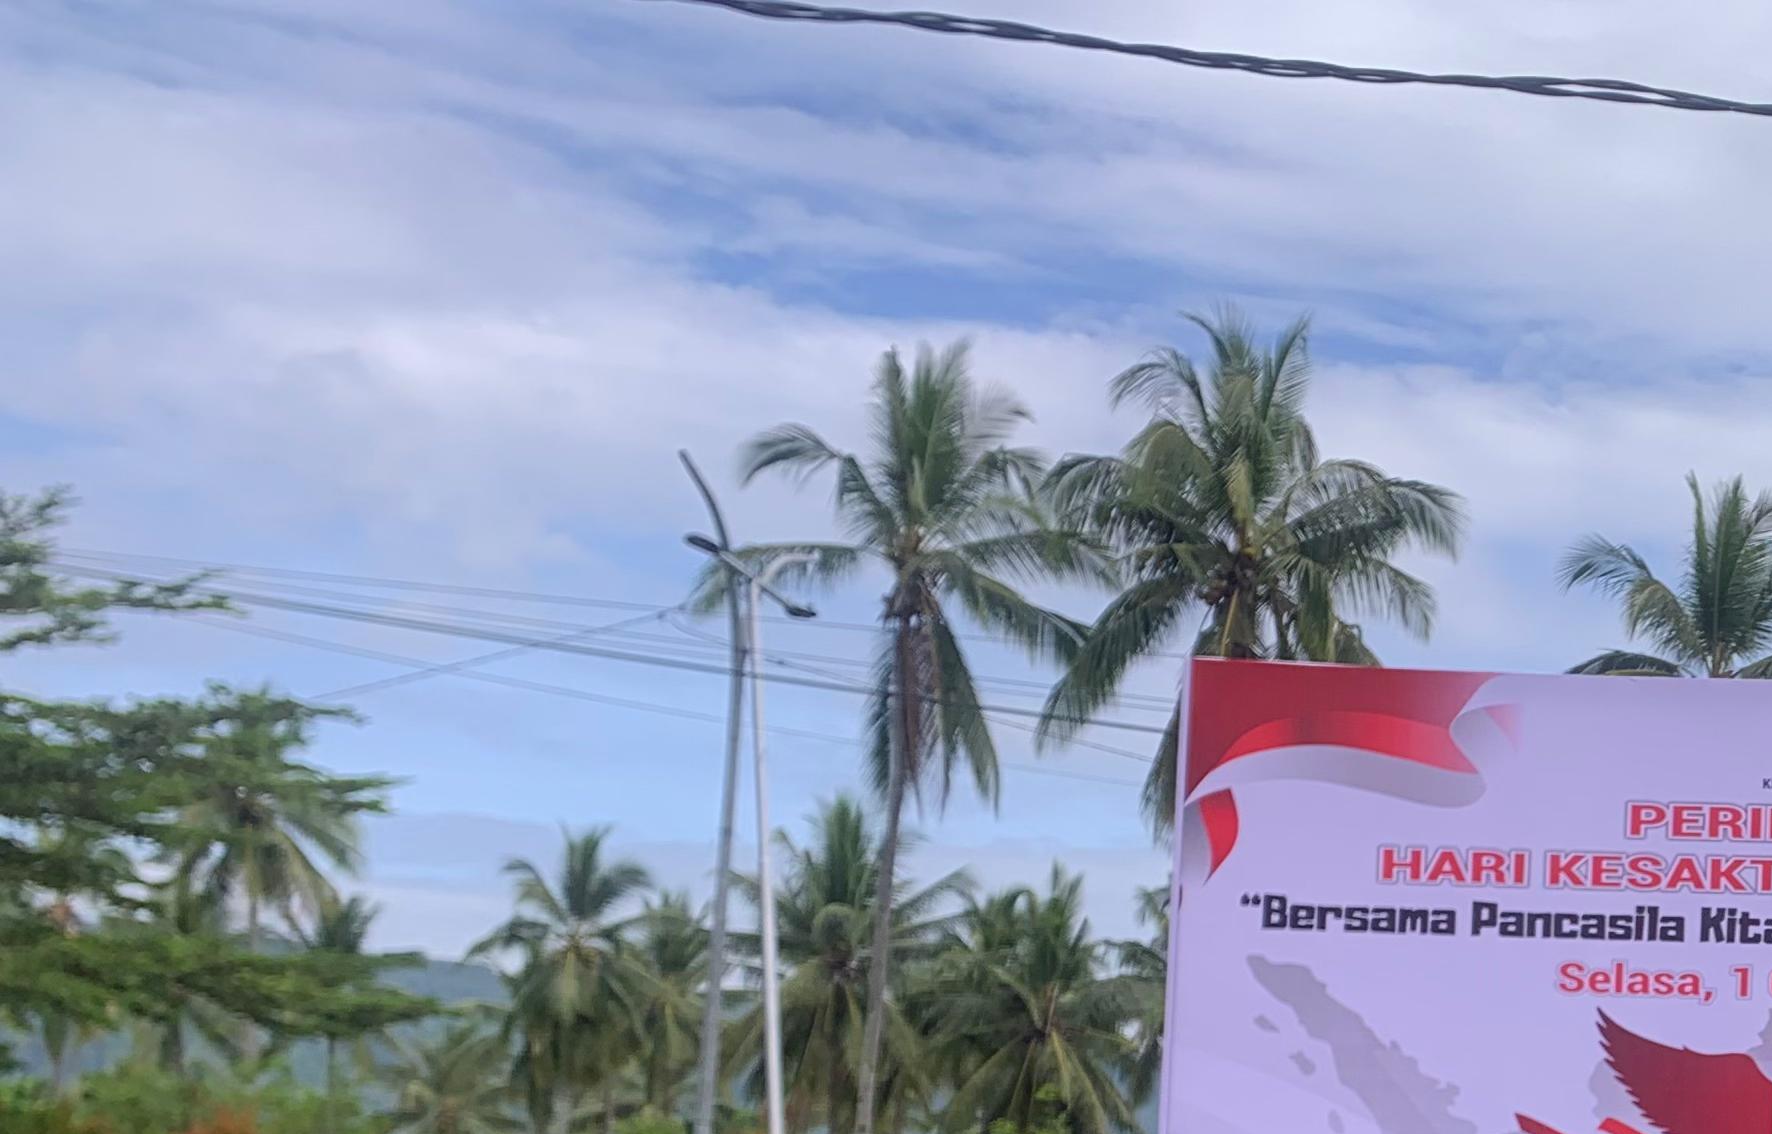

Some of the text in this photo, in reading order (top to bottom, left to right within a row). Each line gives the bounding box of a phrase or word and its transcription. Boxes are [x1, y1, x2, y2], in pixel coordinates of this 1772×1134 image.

[1380, 846, 1528, 887] HARI
[1470, 901, 1686, 944] Pancasila
[1558, 961, 1714, 1003] Selasa,
[1734, 965, 1752, 999] 1
